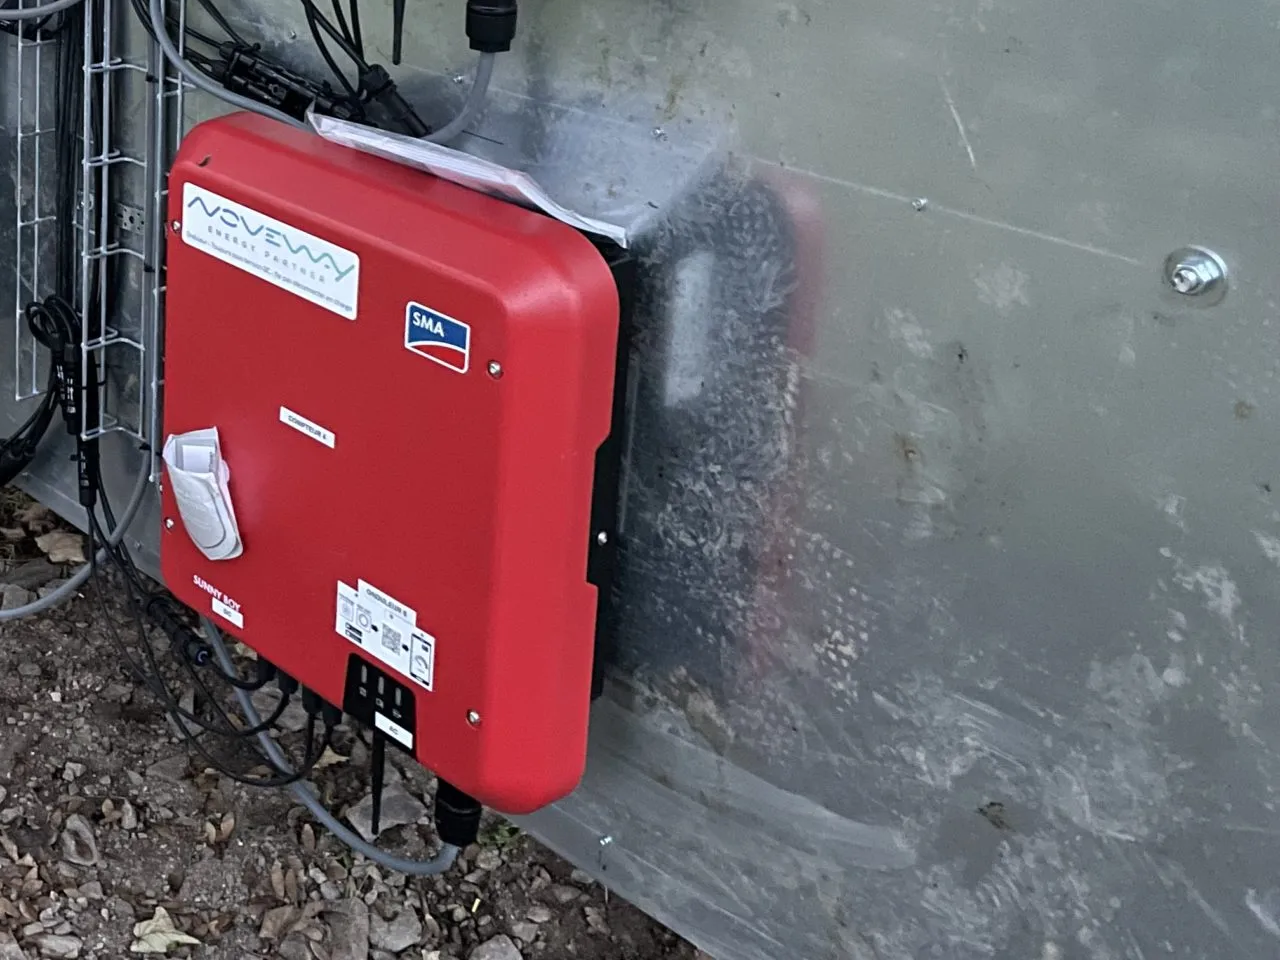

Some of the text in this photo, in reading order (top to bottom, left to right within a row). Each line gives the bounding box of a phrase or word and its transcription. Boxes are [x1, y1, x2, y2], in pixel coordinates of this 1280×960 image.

[187, 196, 356, 283] NOVEWAY
[208, 224, 326, 284] ENERGY PARTNER
[412, 311, 445, 338] SMA
[193, 574, 241, 612] SUNNY BOY
